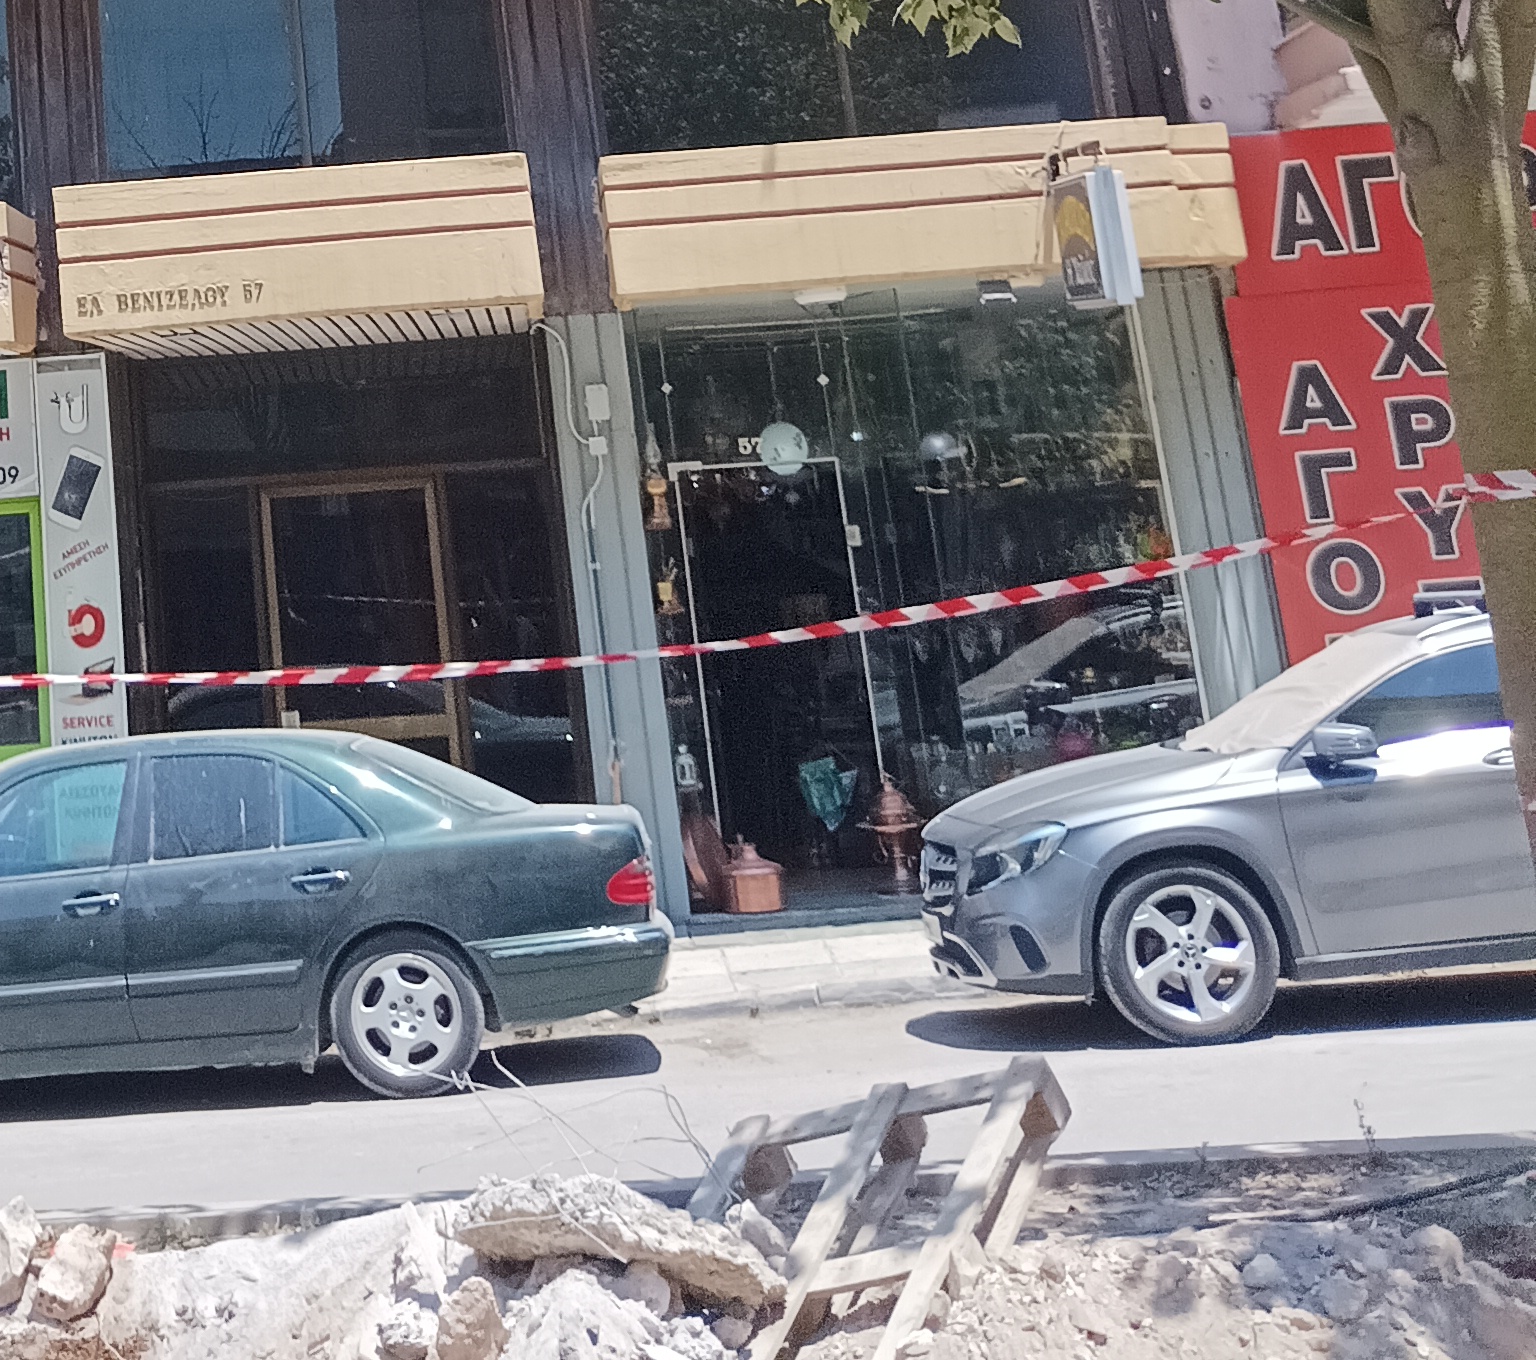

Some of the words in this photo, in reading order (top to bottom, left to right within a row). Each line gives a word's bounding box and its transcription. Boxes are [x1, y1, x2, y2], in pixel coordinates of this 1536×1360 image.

[242, 279, 264, 304] 57
[1279, 359, 1386, 646] ΑΓΟ
[1360, 303, 1484, 596] ΧΡΥ
[62, 714, 114, 730] SERVICE
